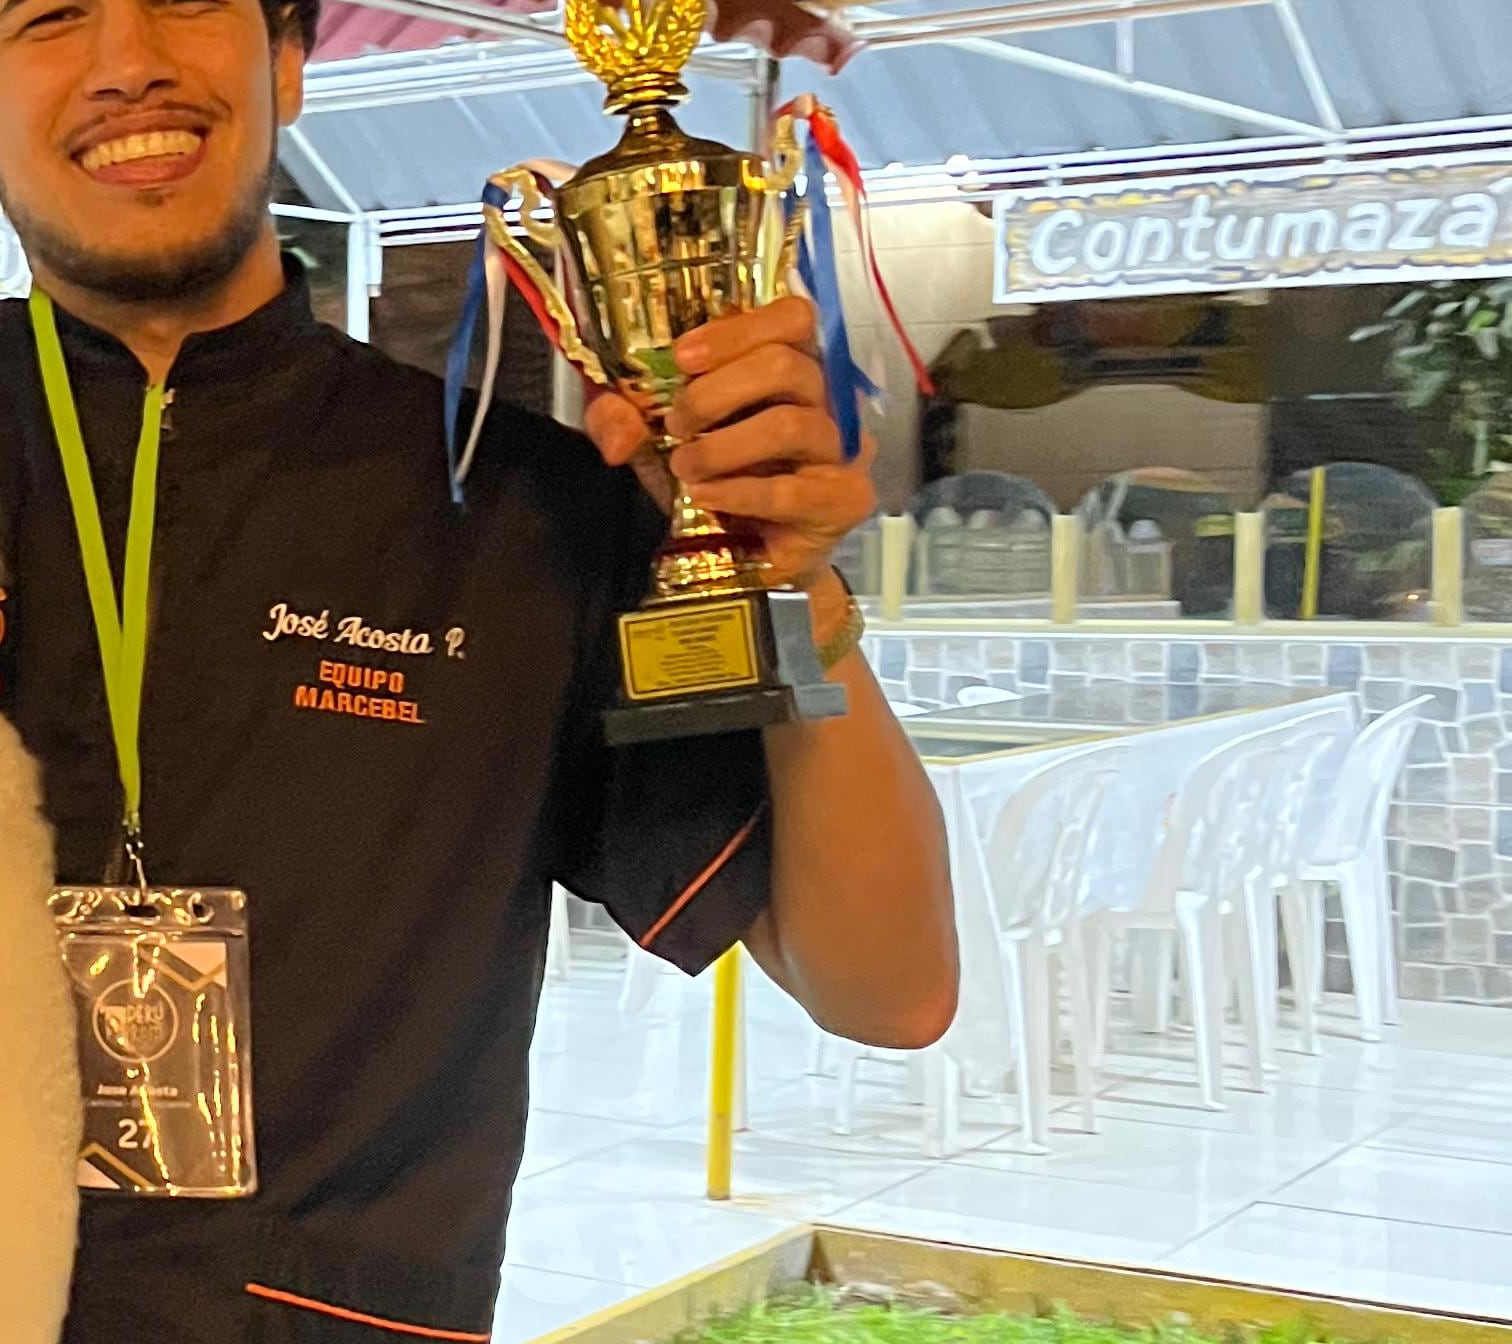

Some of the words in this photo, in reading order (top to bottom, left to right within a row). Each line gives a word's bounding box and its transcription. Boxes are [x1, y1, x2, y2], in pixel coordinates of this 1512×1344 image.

[263, 603, 330, 641] José
[334, 616, 434, 654] Acosta
[319, 660, 405, 693] EQUIPO
[295, 685, 427, 724] MARCEBEL
[118, 1118, 156, 1149] 27
